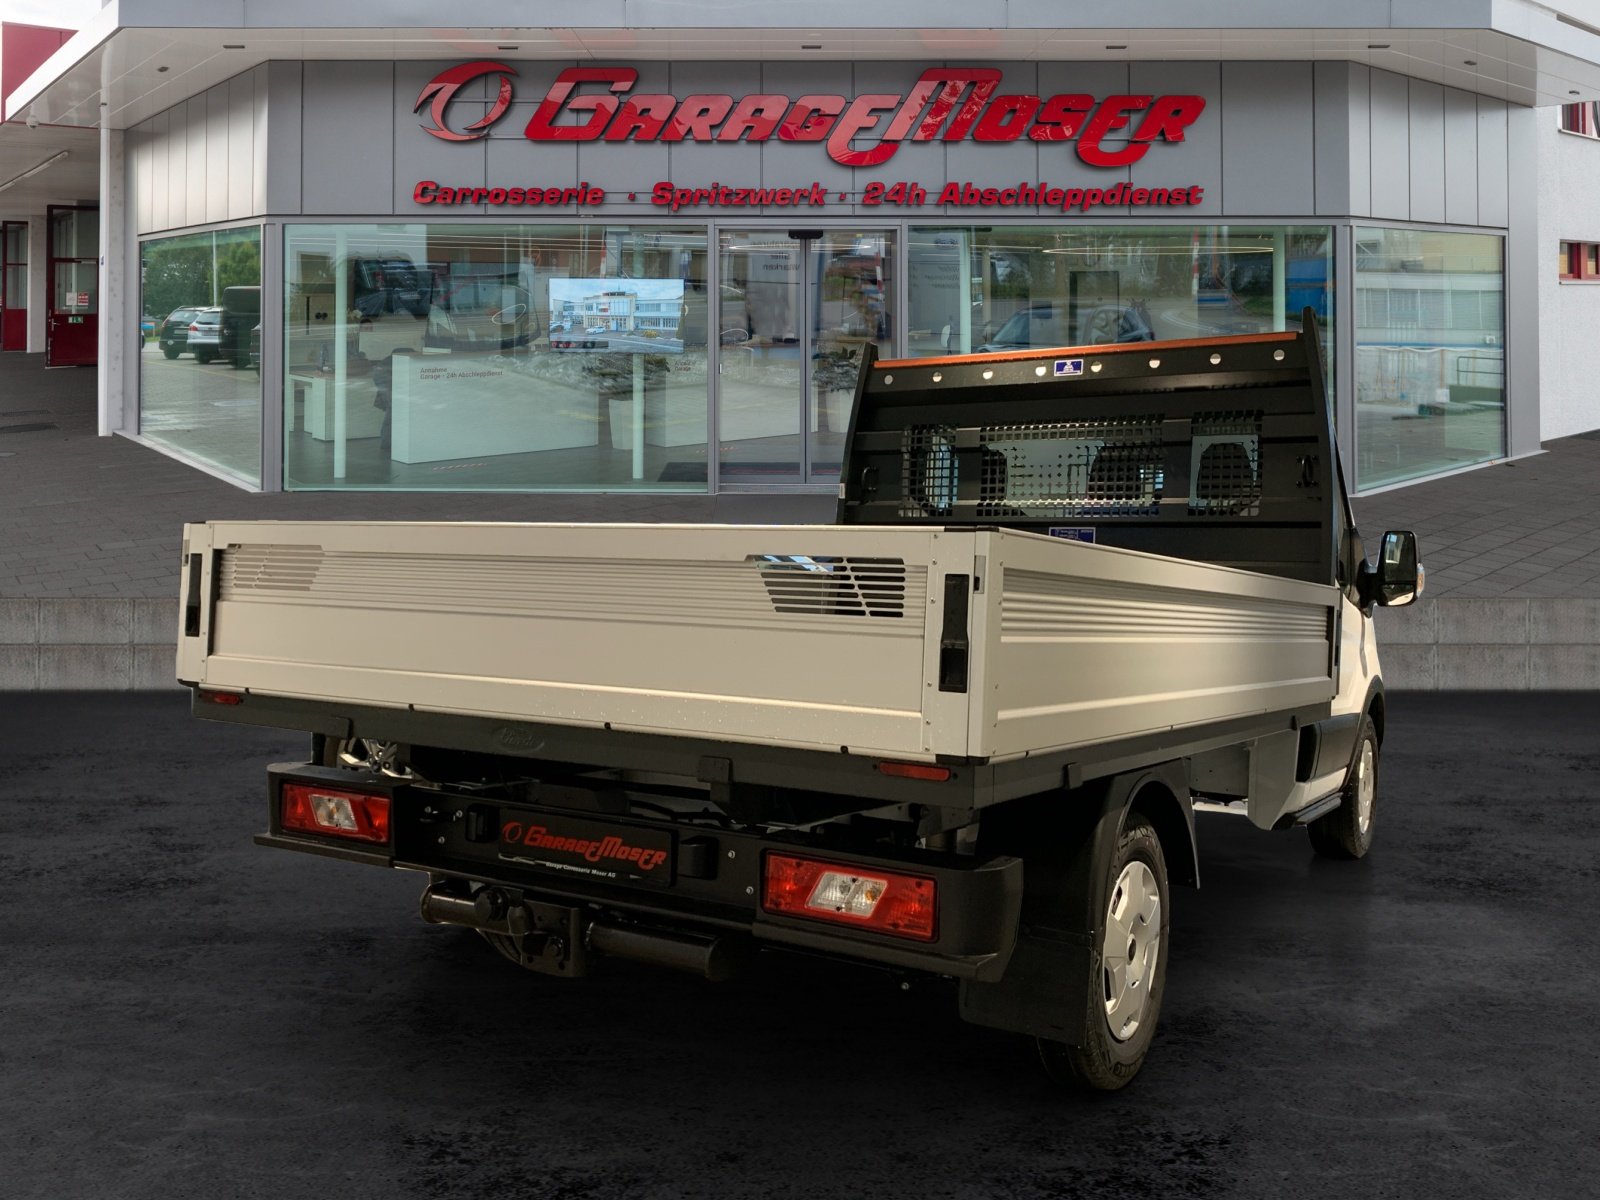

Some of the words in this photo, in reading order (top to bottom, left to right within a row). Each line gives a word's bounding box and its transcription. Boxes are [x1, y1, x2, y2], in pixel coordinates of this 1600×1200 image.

[413, 181, 605, 206] Carrosserie
[650, 181, 827, 212] Spritzwerk
[862, 181, 927, 206] 24h
[935, 181, 1204, 212] Abschleppdienst
[420, 373, 441, 381] Garage
[458, 370, 503, 379] Abschleppdienst
